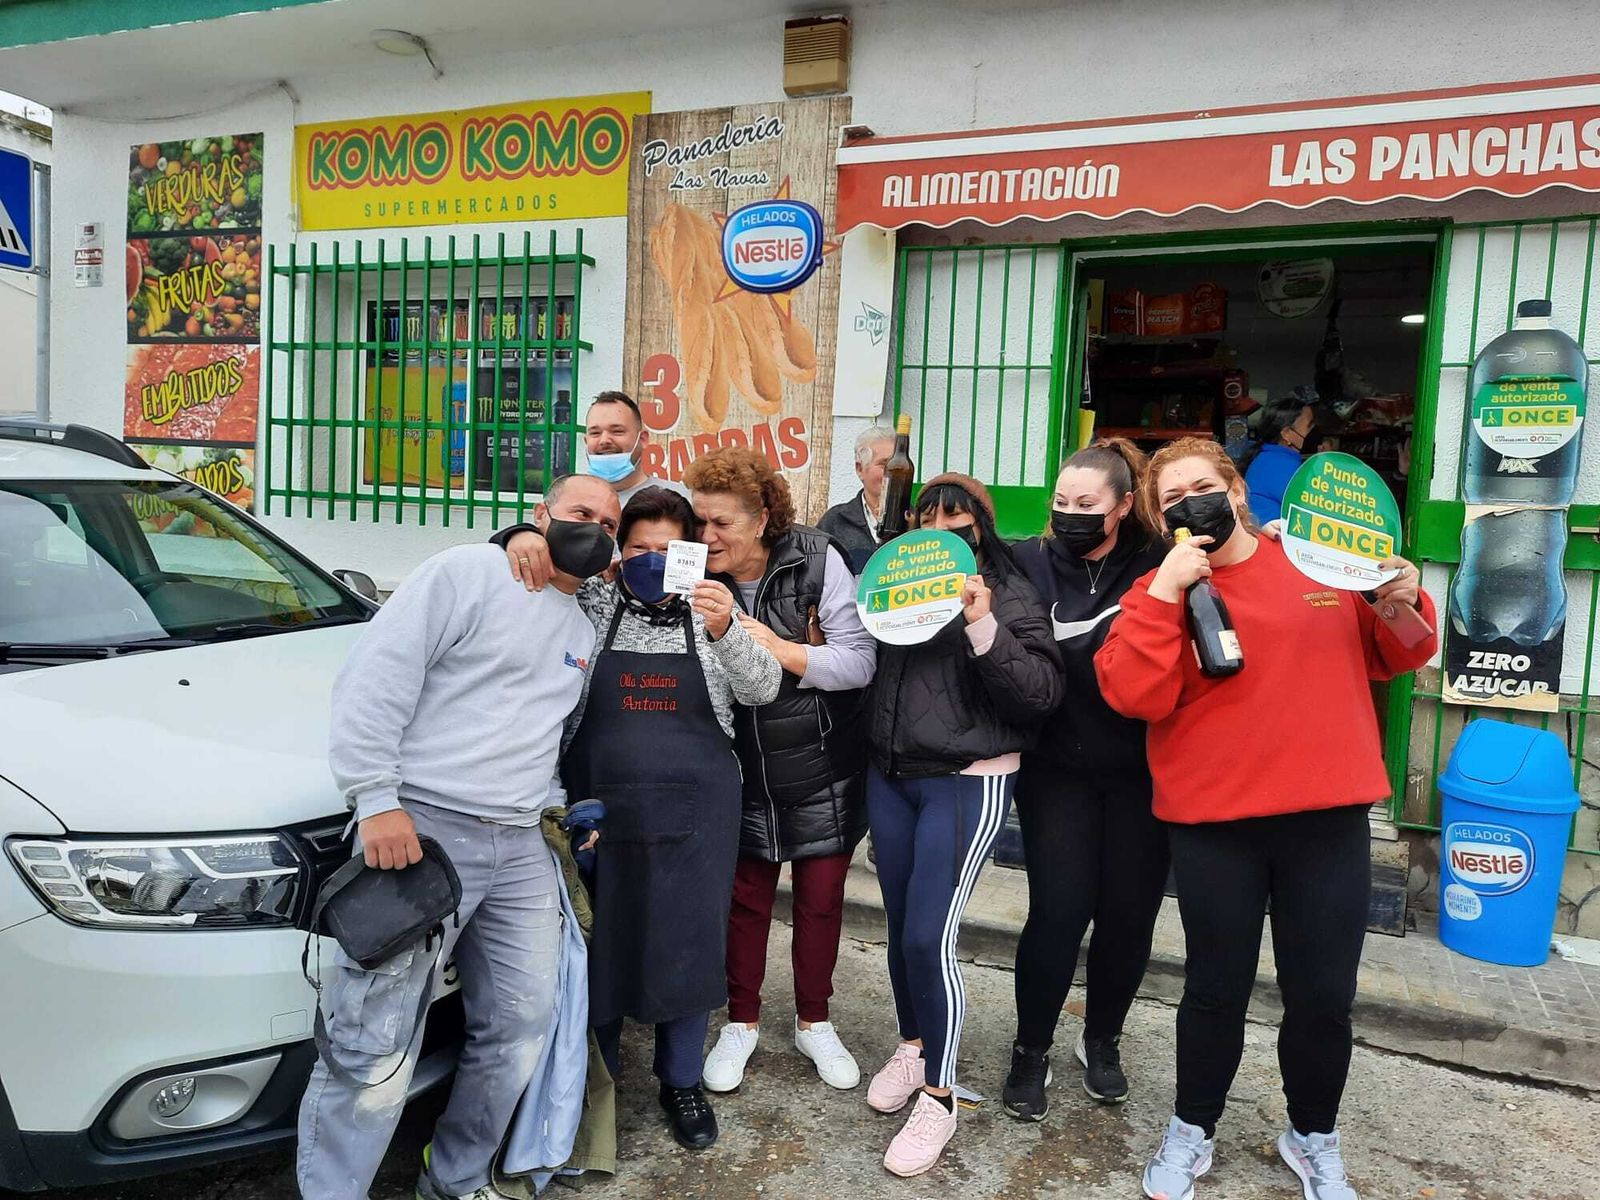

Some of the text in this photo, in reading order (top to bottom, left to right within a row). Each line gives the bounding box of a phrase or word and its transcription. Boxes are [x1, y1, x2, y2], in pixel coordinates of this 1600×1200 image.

[311, 111, 626, 187] KOMO KOMO
[643, 115, 784, 174] Panadería
[1269, 117, 1600, 188] LAS PANCHAS
[144, 154, 244, 217] VERDURAS
[670, 167, 770, 190] Las Navas
[882, 160, 1120, 208] ALIMENTACIÓN
[364, 193, 558, 218] SUPERMERCADOS
[741, 211, 796, 227] HELADOS
[735, 237, 804, 264] Nestlé
[158, 260, 227, 315] FRUTAS
[141, 356, 243, 426] EMBUTIDOS
[640, 353, 682, 432] 3
[1491, 392, 1567, 403] autorizado
[1499, 382, 1560, 392] de venta
[1508, 409, 1569, 424] ONCE
[1323, 461, 1367, 489] Punto
[1497, 457, 1541, 474] MAX
[1311, 475, 1377, 509] de venta
[1300, 490, 1385, 527] autorizado
[897, 540, 941, 556] Punto
[1317, 522, 1389, 558] ONCE
[877, 560, 956, 585] autorizado
[887, 550, 950, 571] de venta
[893, 577, 958, 605] ONCE
[1466, 651, 1531, 672] ZERO
[619, 672, 677, 689] Olla Solidaria
[620, 695, 677, 711] Antonia
[1454, 828, 1512, 844] HELADOS
[1451, 849, 1523, 875] Nestlé
